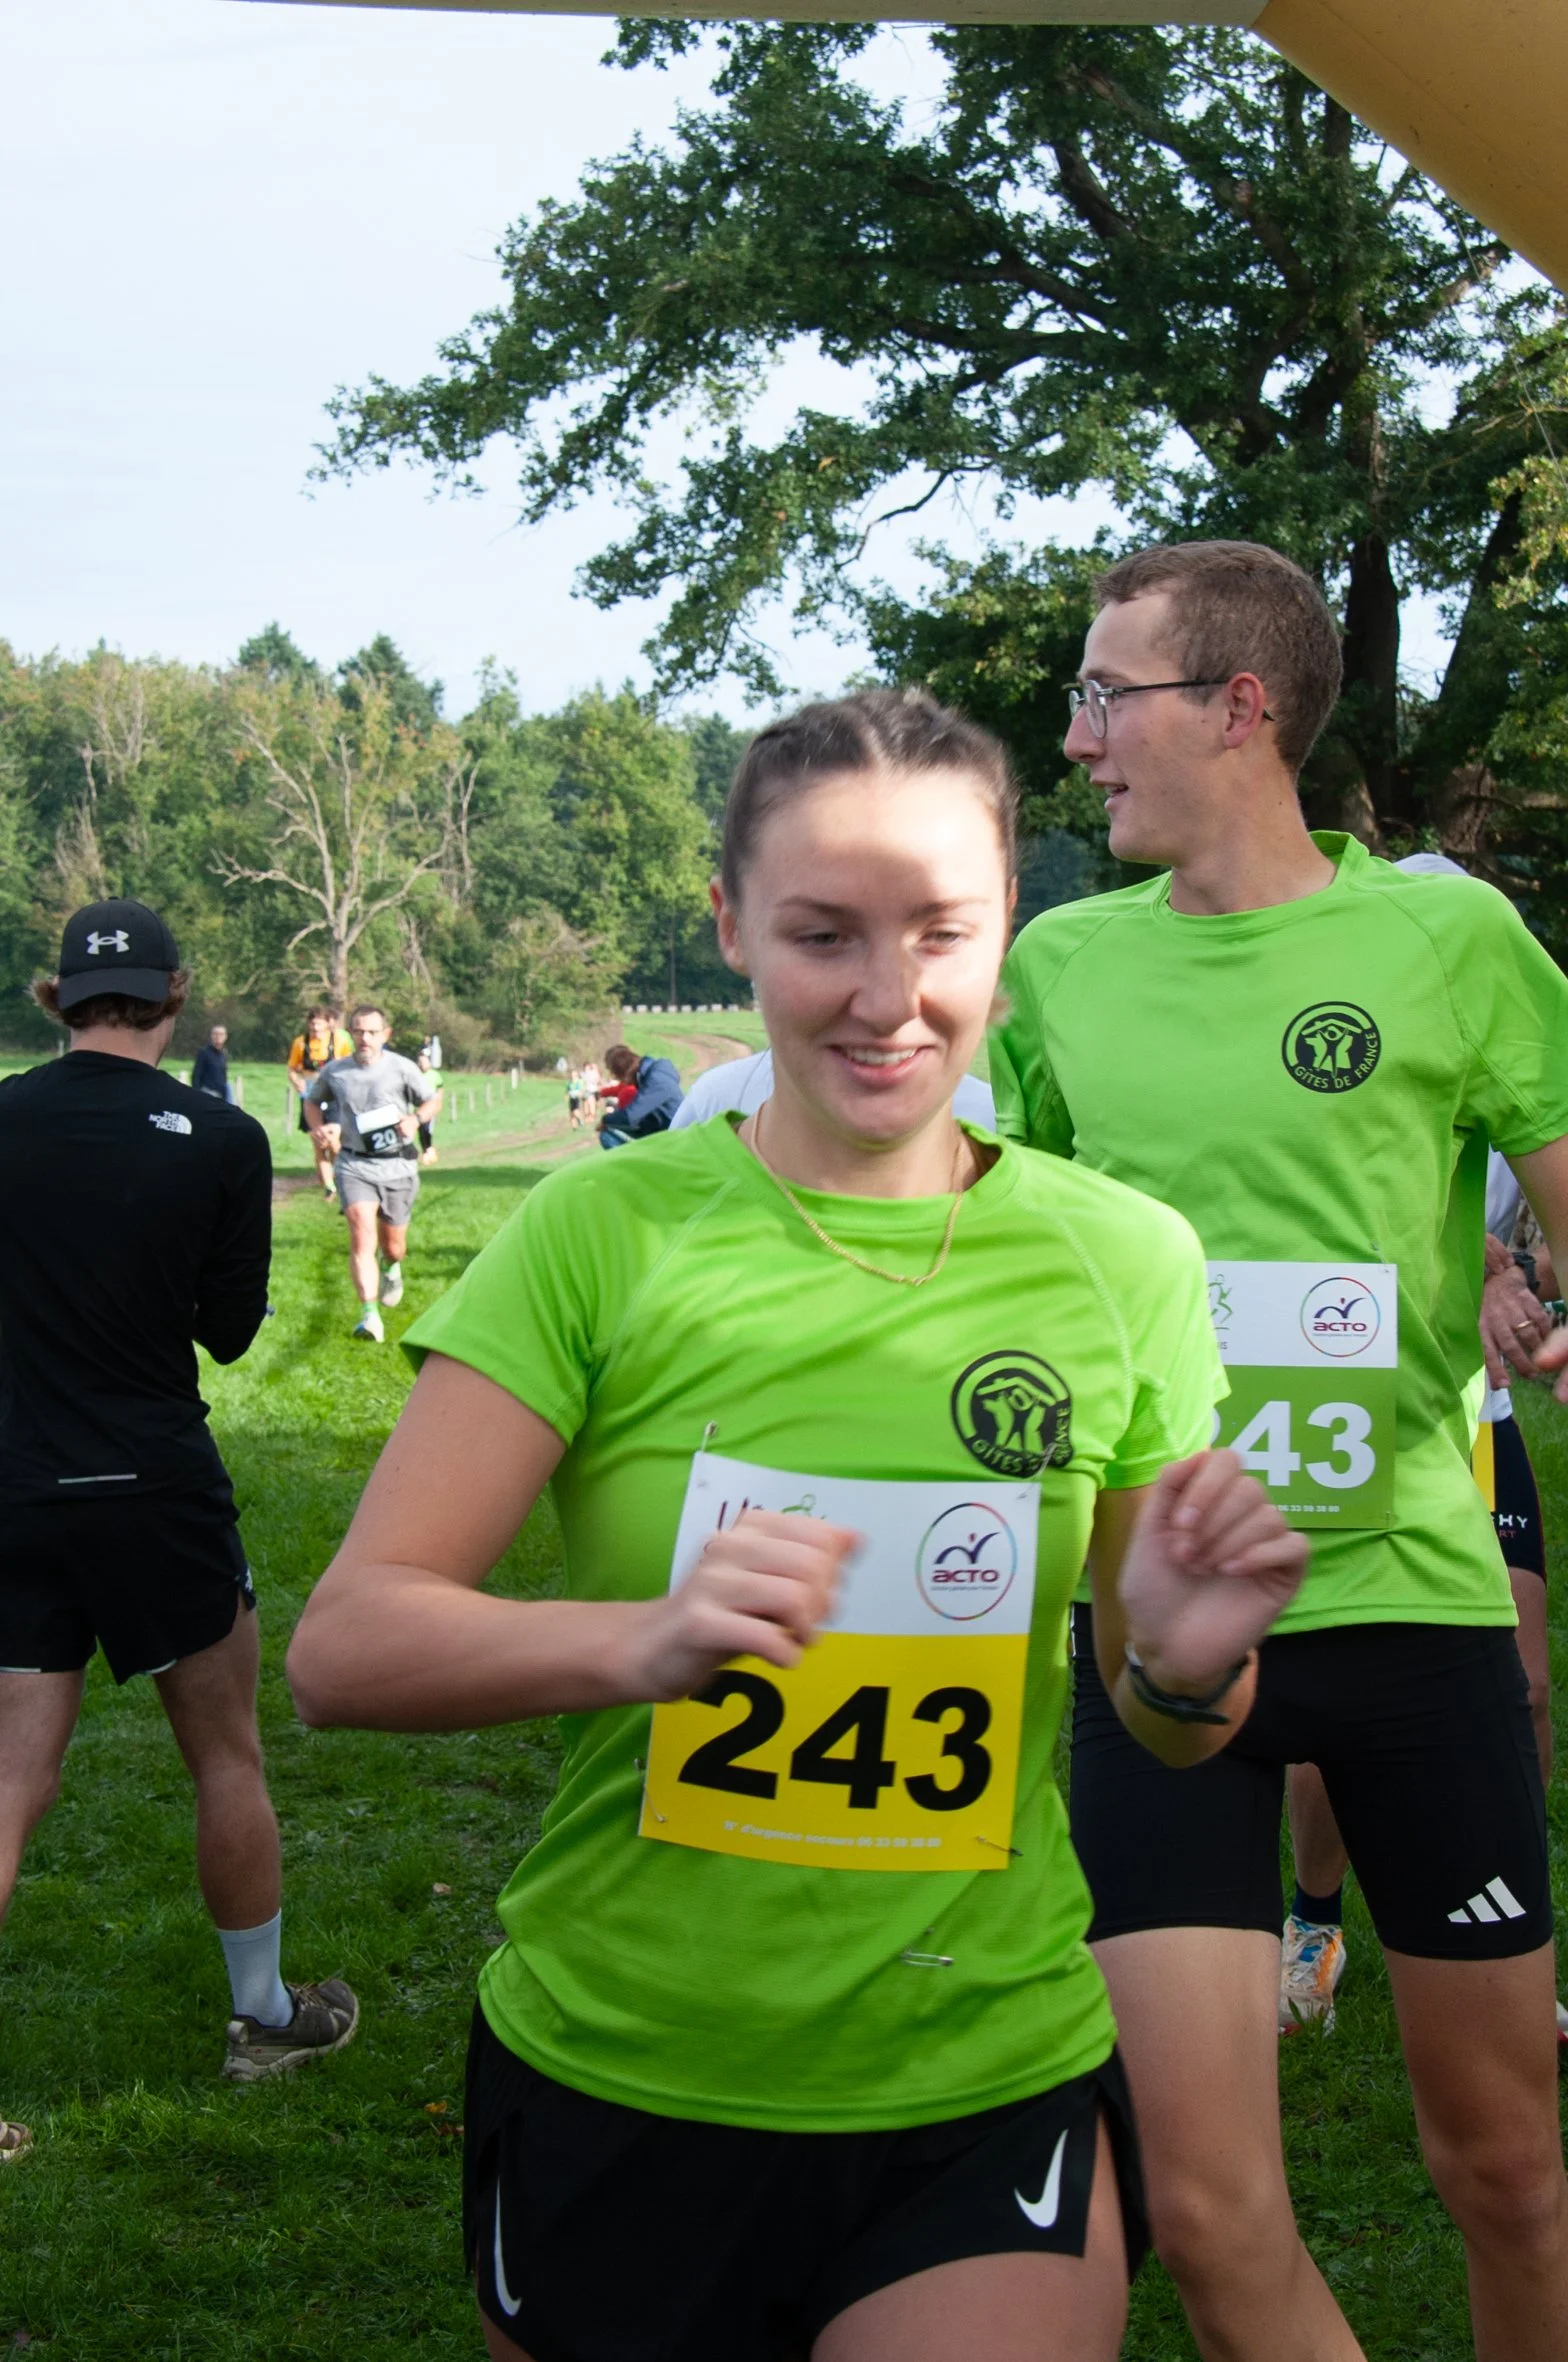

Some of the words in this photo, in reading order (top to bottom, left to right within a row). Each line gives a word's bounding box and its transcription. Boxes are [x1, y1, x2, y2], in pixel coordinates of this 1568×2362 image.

[1334, 1076, 1353, 1089] DE
[1354, 1032, 1378, 1079] FRANCE
[1210, 1400, 1376, 1489] 43
[1496, 1513, 1528, 1529] HY
[677, 1669, 993, 1812] 243
